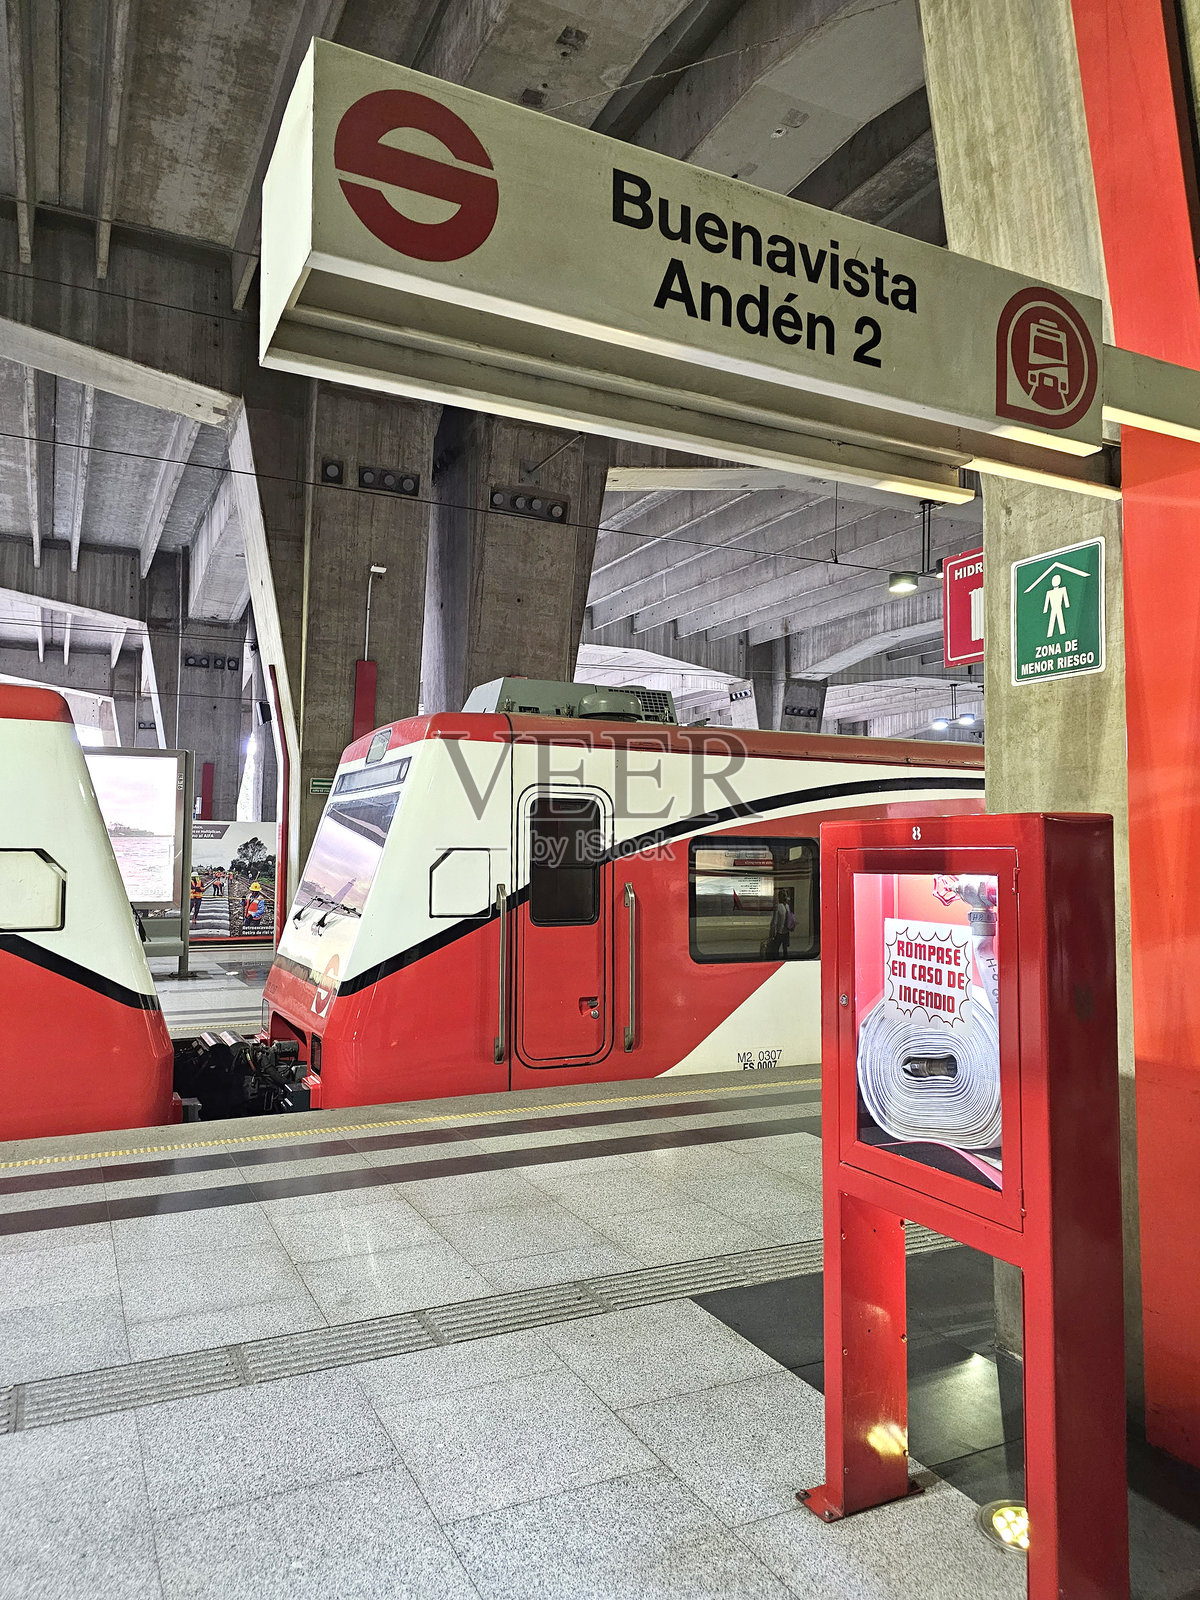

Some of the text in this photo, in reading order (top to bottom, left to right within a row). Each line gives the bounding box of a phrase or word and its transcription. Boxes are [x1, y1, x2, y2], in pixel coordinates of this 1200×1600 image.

[612, 167, 917, 314] Buenavista
[653, 257, 882, 368] Andén 2
[1035, 639, 1078, 658] ZONA DE
[1021, 651, 1095, 676] MENOR RIESGO
[911, 825, 922, 841] 8
[897, 940, 961, 967] ROMPASE
[891, 959, 965, 990] EN CASO DE
[899, 984, 956, 1014] INCENDIO
[758, 1049, 783, 1061] 0307
